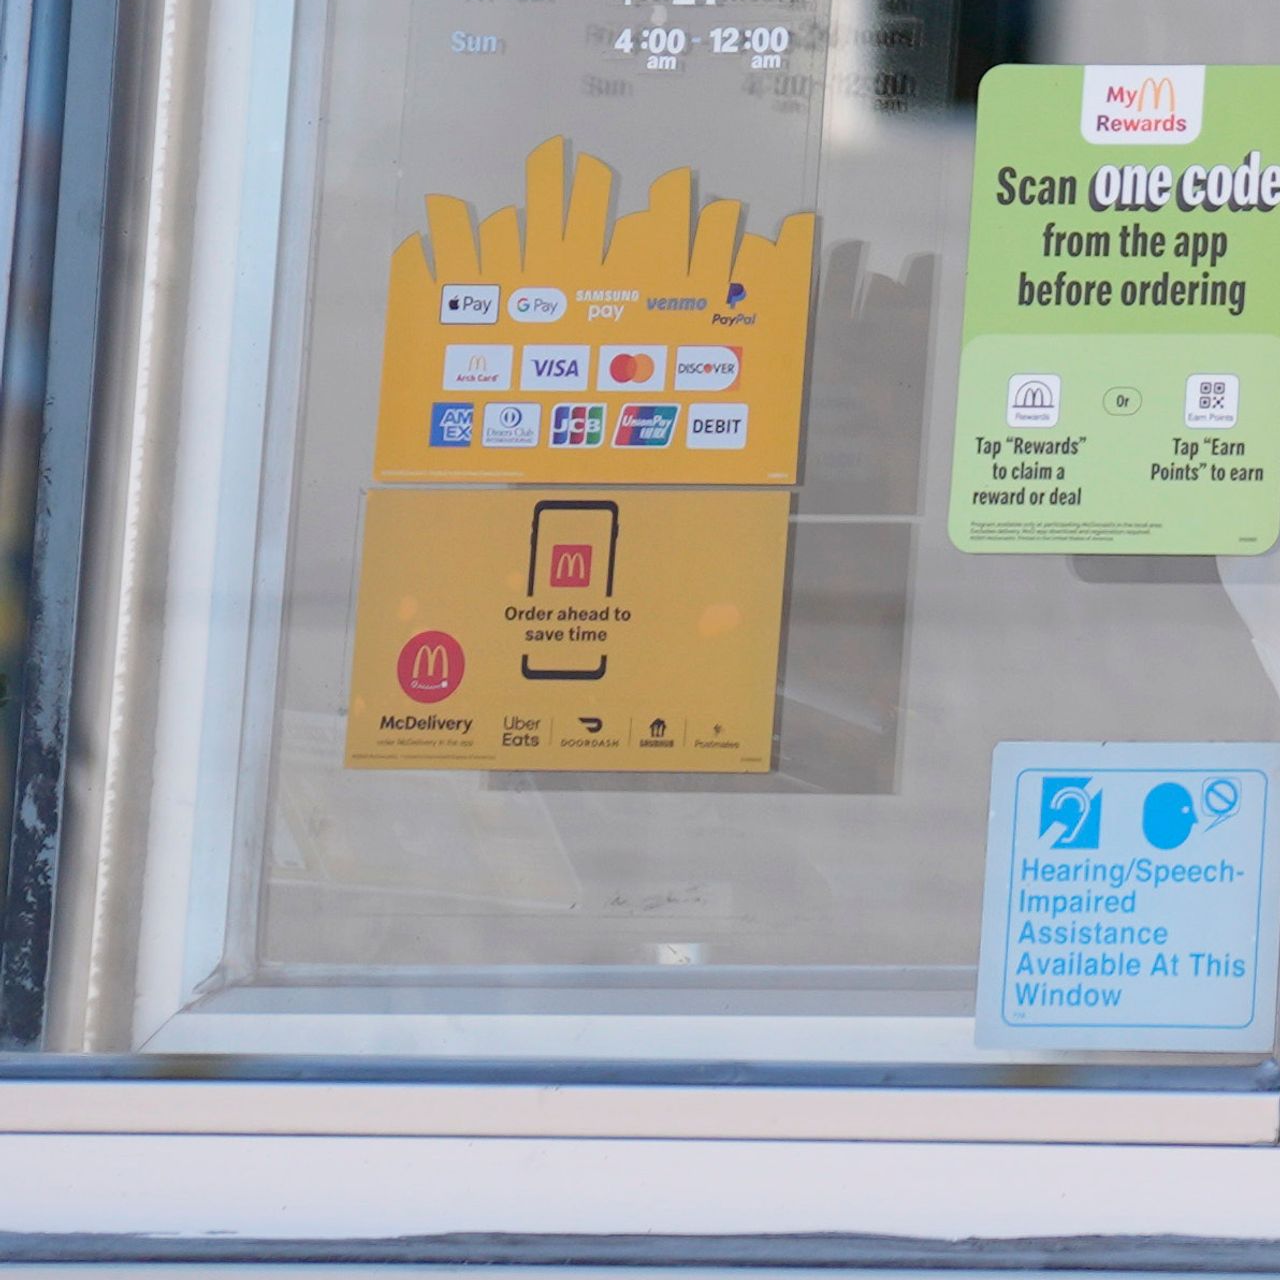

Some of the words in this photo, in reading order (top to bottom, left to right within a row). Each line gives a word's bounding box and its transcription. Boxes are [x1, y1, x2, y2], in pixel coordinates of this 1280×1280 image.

[450, 31, 497, 53] Sun
[709, 27, 789, 53] 12:00
[647, 55, 676, 69] am
[751, 54, 781, 69] am
[1106, 86, 1138, 108] My
[1096, 115, 1187, 132] Rewards
[996, 166, 1077, 206] Scan
[1089, 164, 1173, 212] one
[1043, 222, 1110, 257] from
[1120, 223, 1166, 257] the
[1174, 231, 1228, 267] app
[1018, 271, 1112, 306] before
[1121, 272, 1246, 316] ordering
[463, 296, 493, 315] Pay
[533, 299, 558, 314] Pay
[588, 303, 625, 321] pay
[647, 297, 708, 311] venmo
[711, 314, 757, 327] PayPal
[531, 360, 579, 377] VISA
[678, 363, 735, 375] DISCOVER
[1116, 394, 1129, 408] Or
[553, 417, 601, 434] JCB
[693, 419, 742, 433] DEBIT
[976, 437, 1001, 459] Tap
[1173, 438, 1199, 460] Tap
[993, 463, 1007, 480] to
[1011, 462, 1051, 480] claim
[1056, 466, 1065, 480] a
[1211, 464, 1226, 481] to
[1230, 468, 1264, 481] earn
[972, 487, 1024, 506] reward
[1029, 491, 1044, 506] or
[1049, 487, 1082, 506] deal
[504, 606, 552, 622] Order
[557, 606, 609, 622] ahead
[613, 607, 631, 622] to
[525, 629, 564, 642] save
[568, 627, 607, 642] time
[379, 715, 473, 734] McDelivery
[503, 716, 541, 731] Uber
[502, 733, 539, 747] Eats
[1020, 857, 1244, 888] Hearing/Speech-
[1019, 889, 1136, 919] Impaired
[1018, 921, 1168, 945] Assistance
[1016, 951, 1140, 976] Available
[1150, 953, 1179, 976] At
[1189, 953, 1246, 977] This
[1016, 982, 1122, 1007] Window
